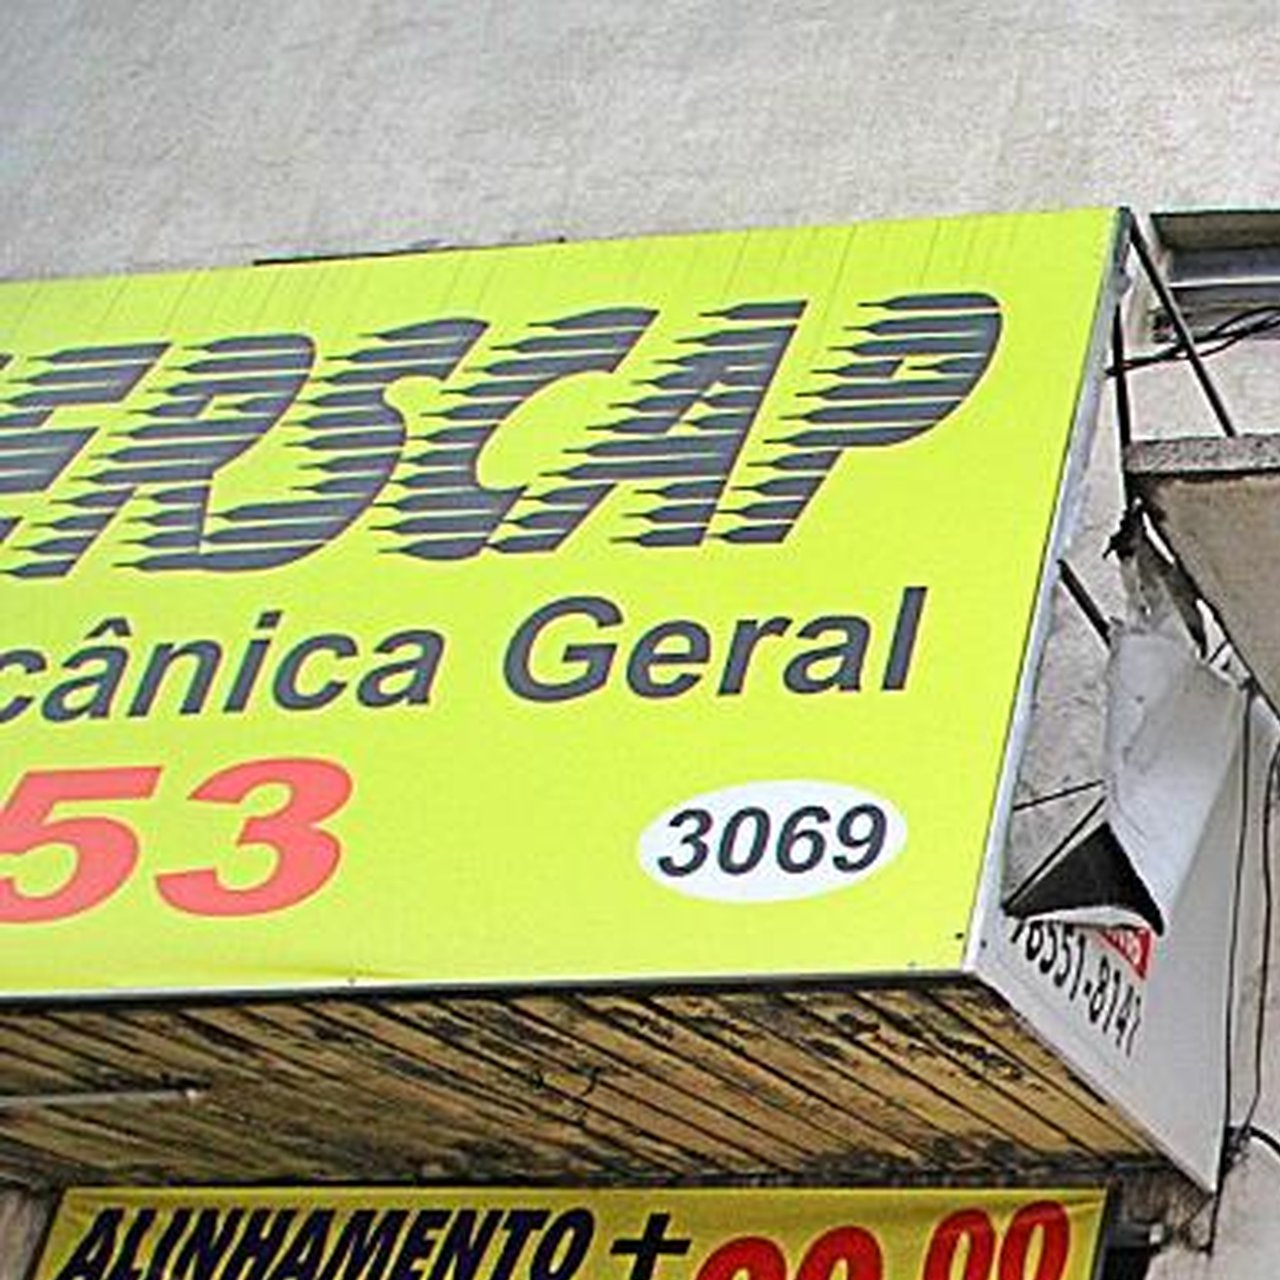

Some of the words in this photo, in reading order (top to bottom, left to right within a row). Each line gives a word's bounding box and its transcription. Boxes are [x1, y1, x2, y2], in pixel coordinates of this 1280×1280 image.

[0, 292, 1003, 578] ERSCAP
[502, 586, 928, 703] Geral
[0, 757, 353, 924] 53
[657, 802, 889, 878] 3069
